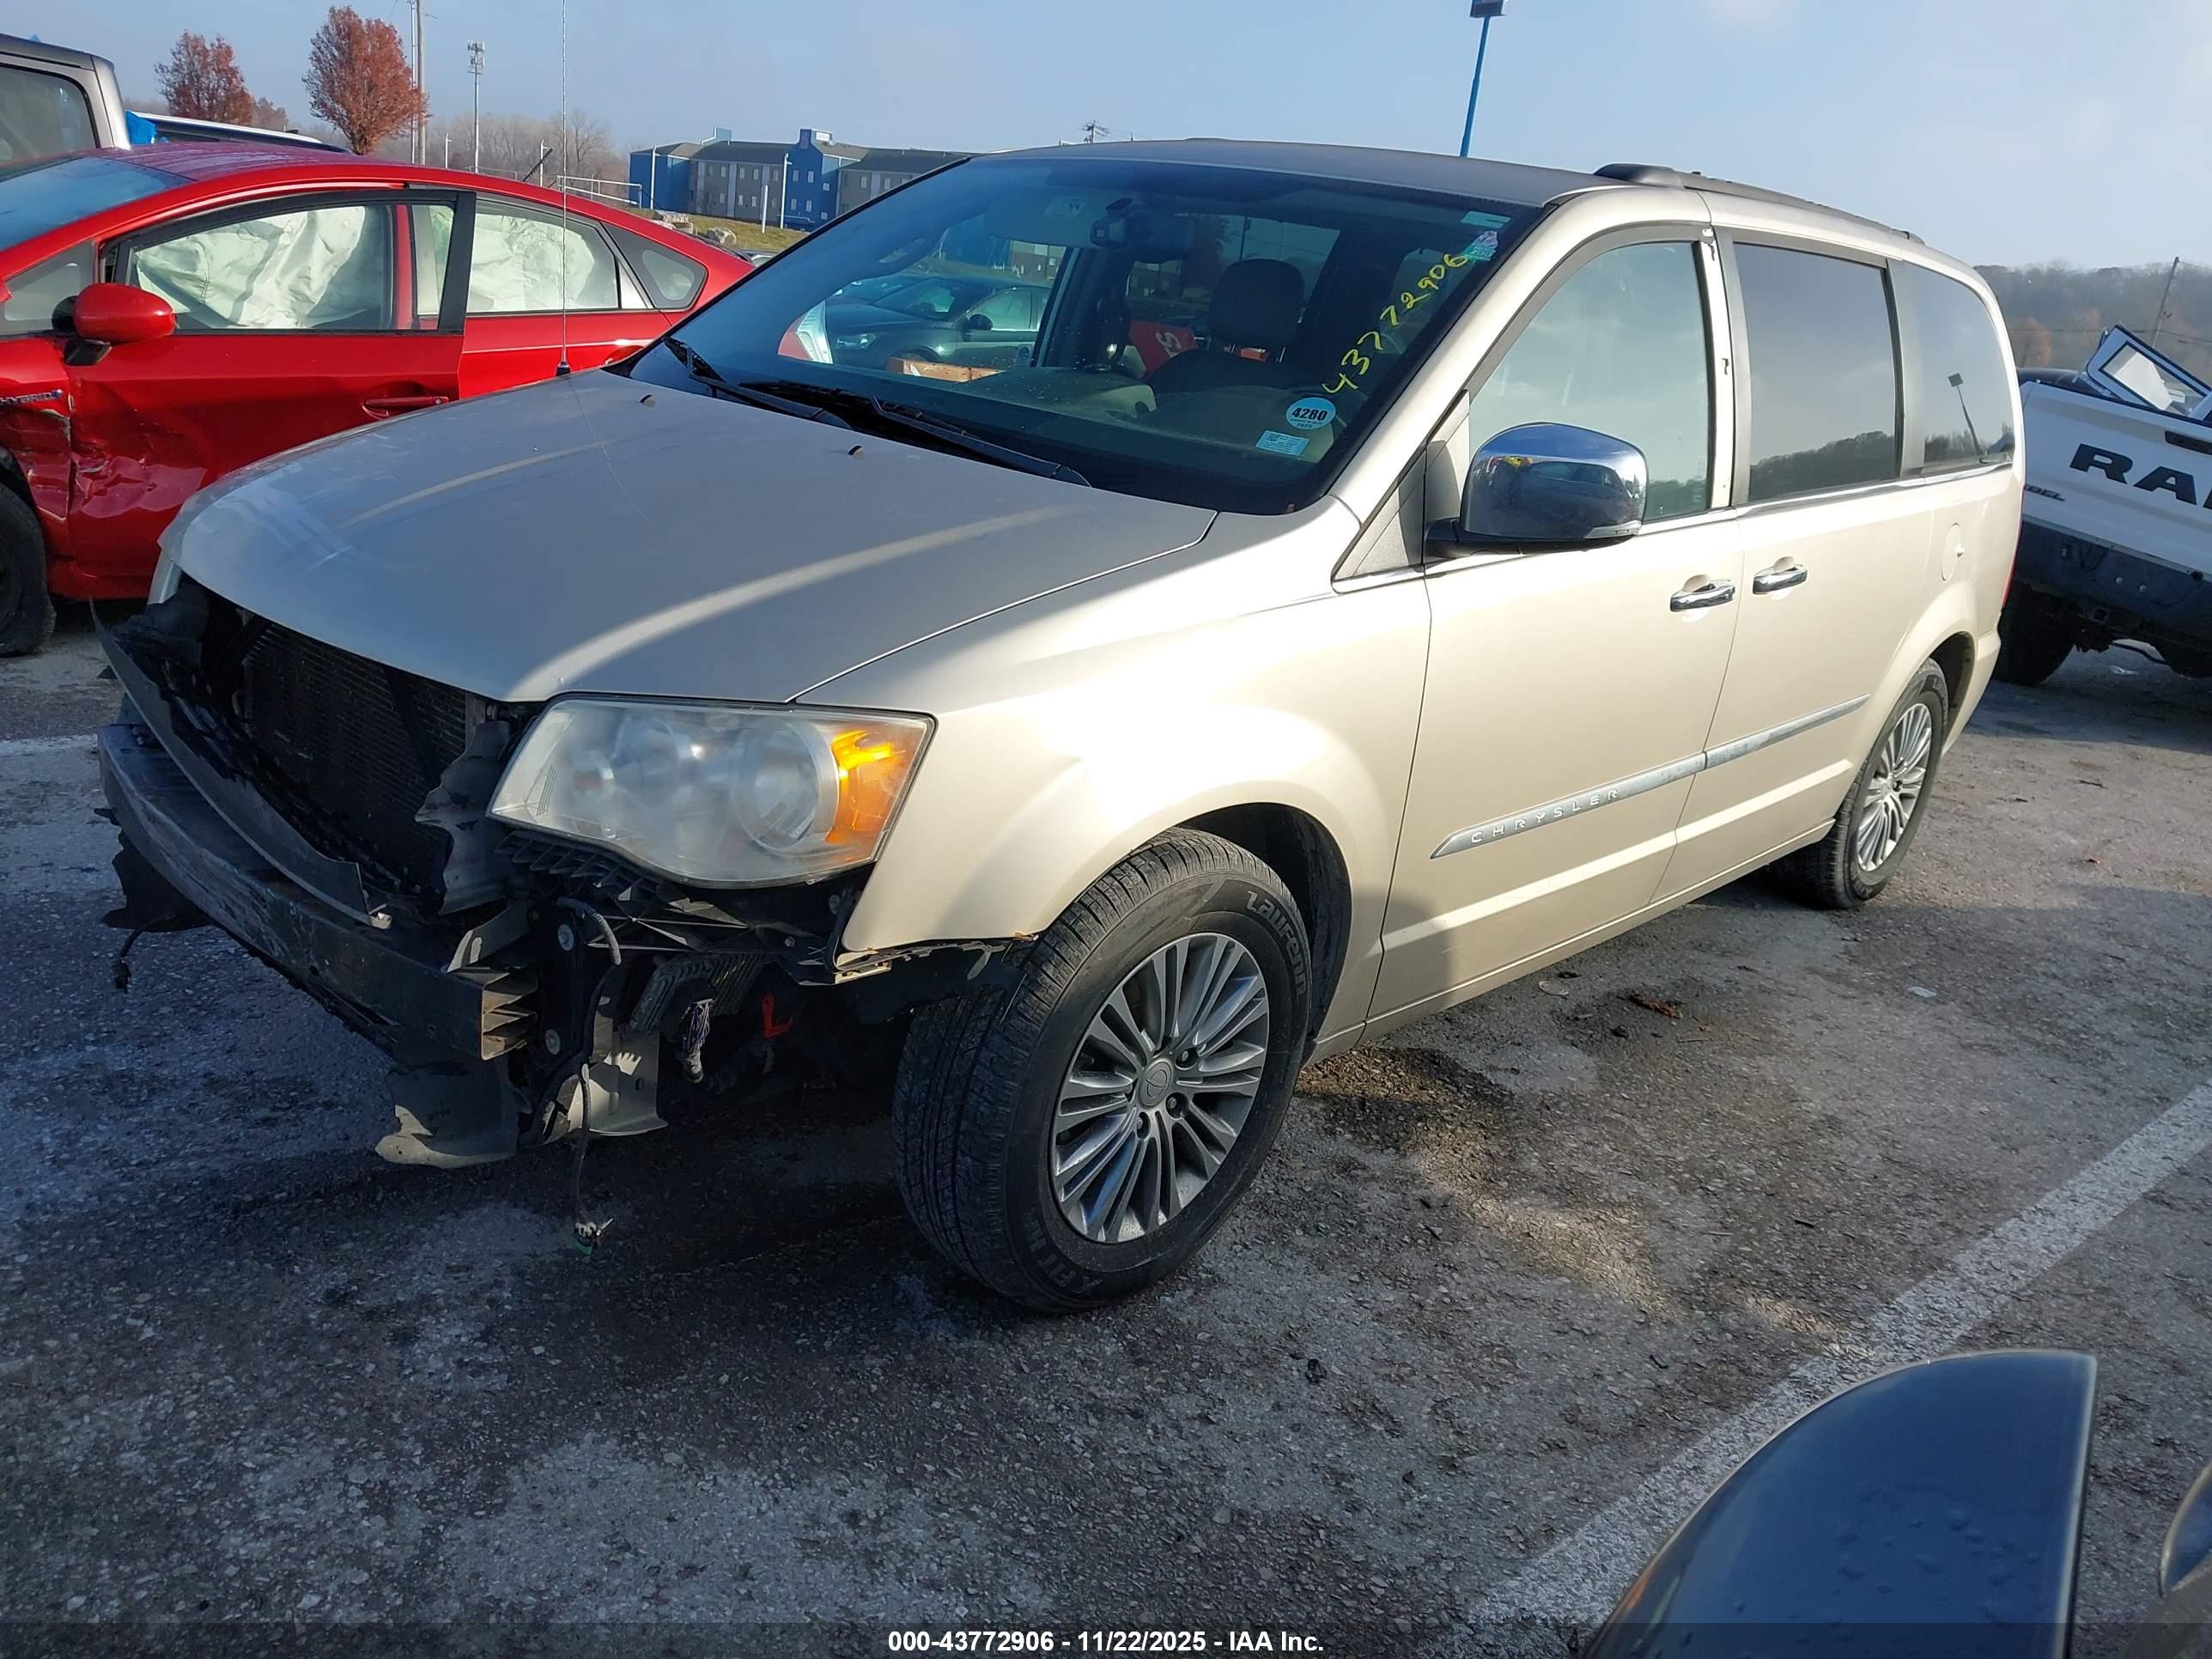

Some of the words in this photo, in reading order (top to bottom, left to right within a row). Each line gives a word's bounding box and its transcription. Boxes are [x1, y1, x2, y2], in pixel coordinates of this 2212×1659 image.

[1322, 253, 1469, 395] 43772906
[1291, 407, 1328, 422] 4280
[2069, 443, 2212, 509] RA
[1471, 788, 1621, 844] CHRYSLER
